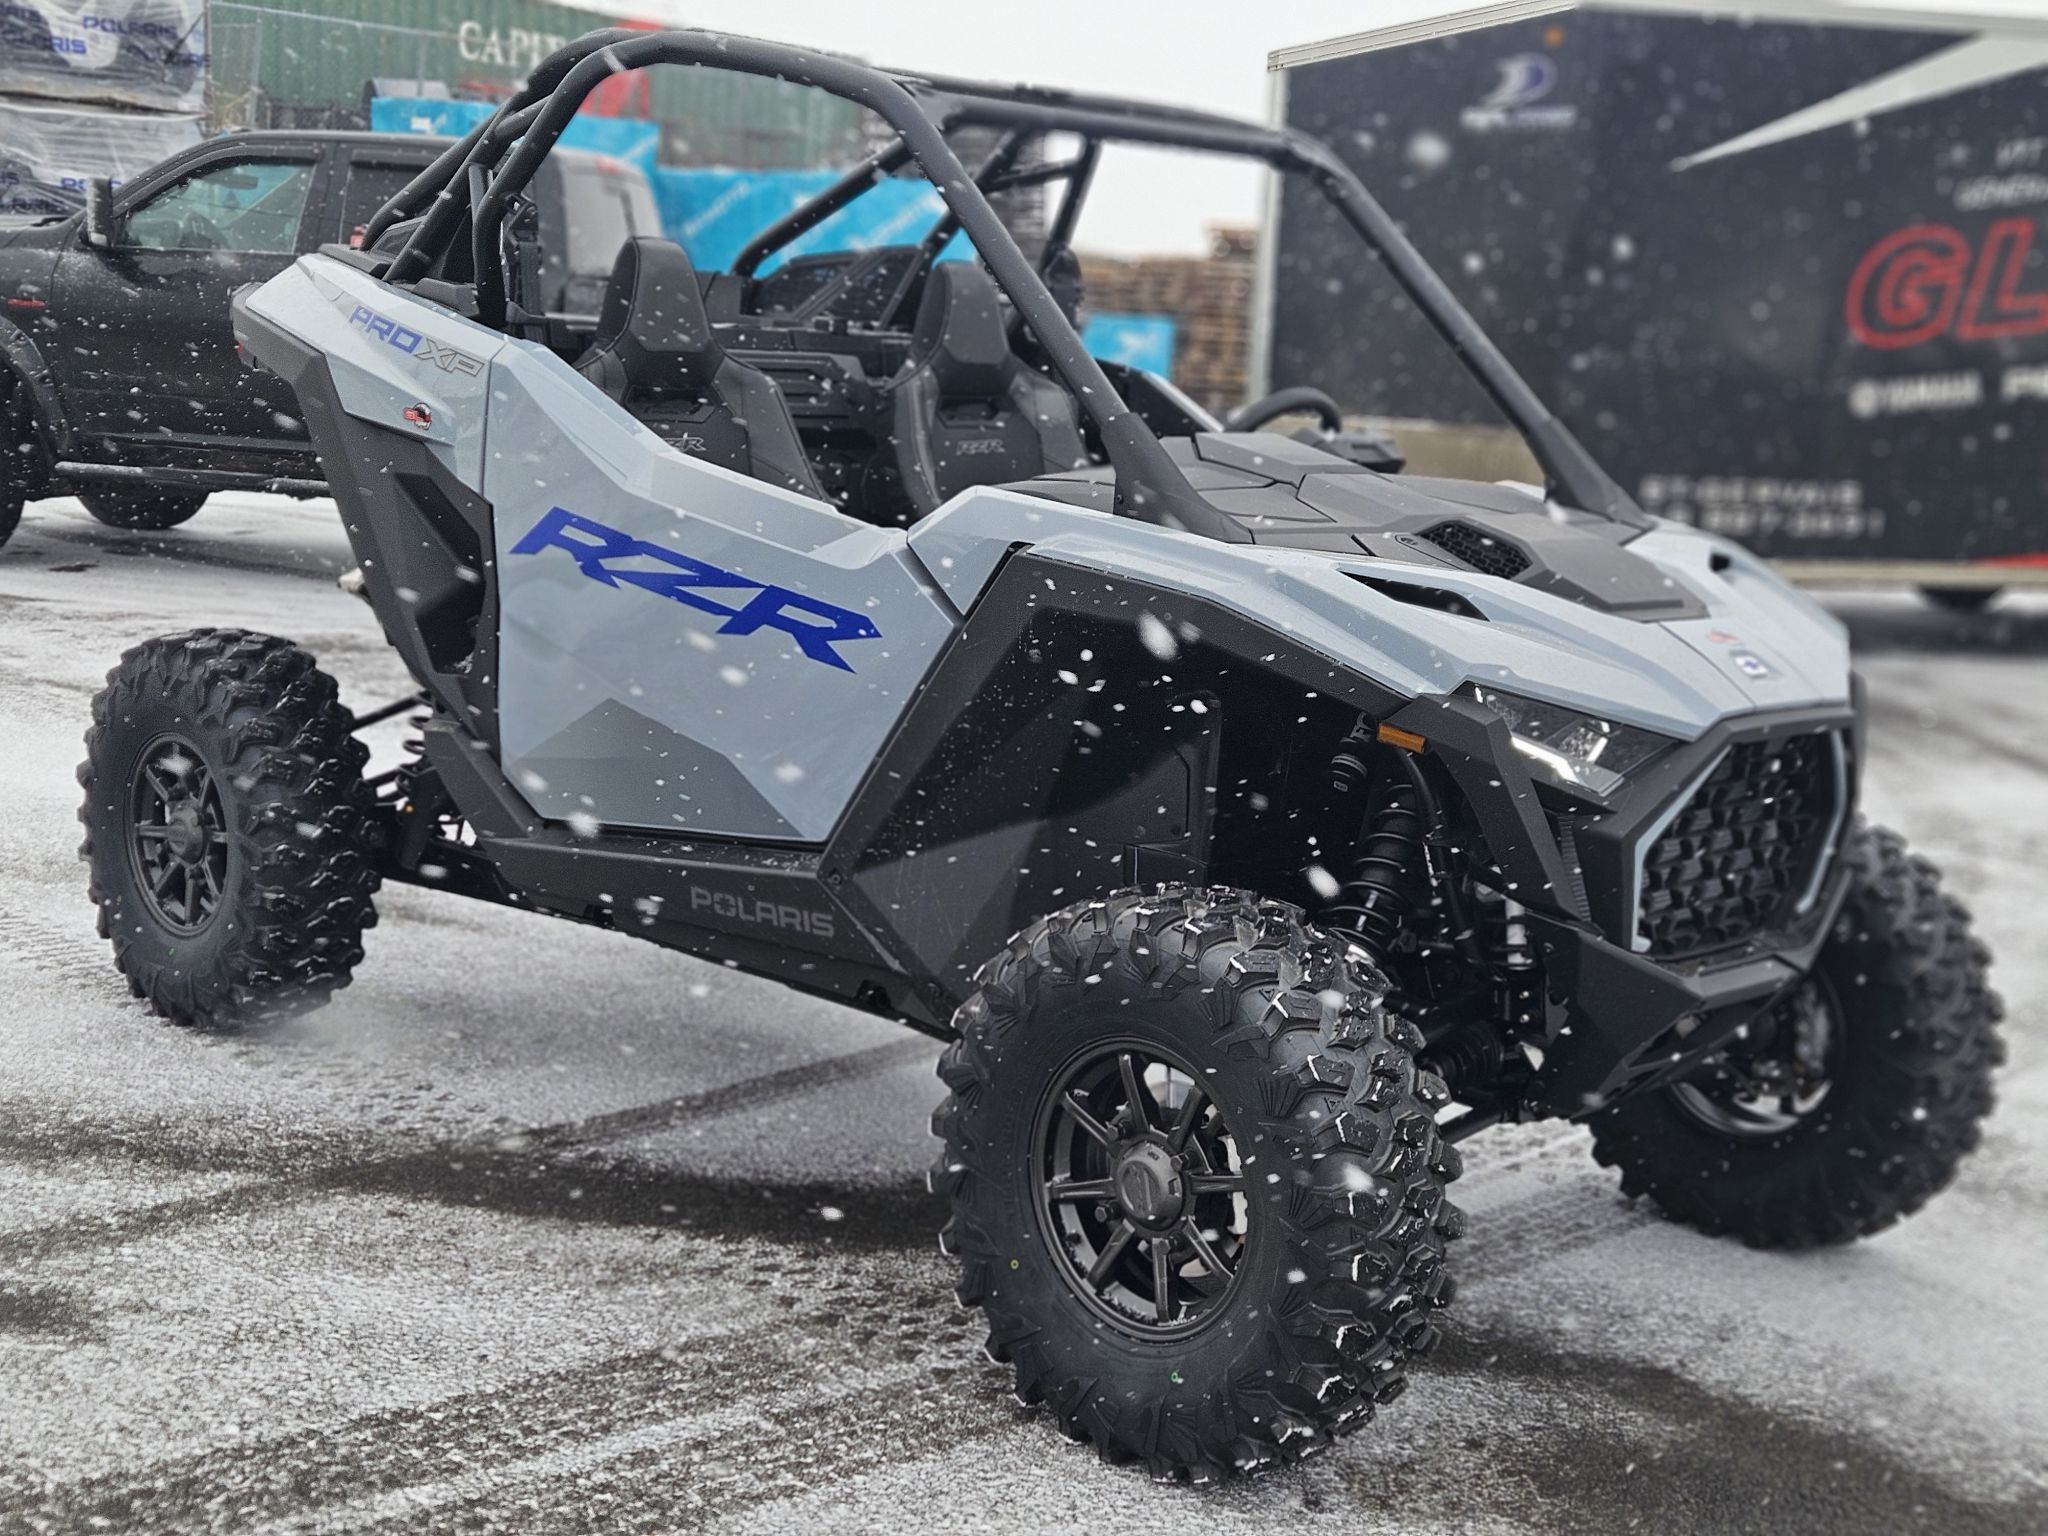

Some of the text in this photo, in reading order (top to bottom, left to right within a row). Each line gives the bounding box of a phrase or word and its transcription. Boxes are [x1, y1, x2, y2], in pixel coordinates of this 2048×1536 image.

[82, 15, 181, 39] POLARIS
[663, 436, 707, 452] ZR
[510, 506, 882, 673] RZR
[690, 886, 835, 938] POLARIS
